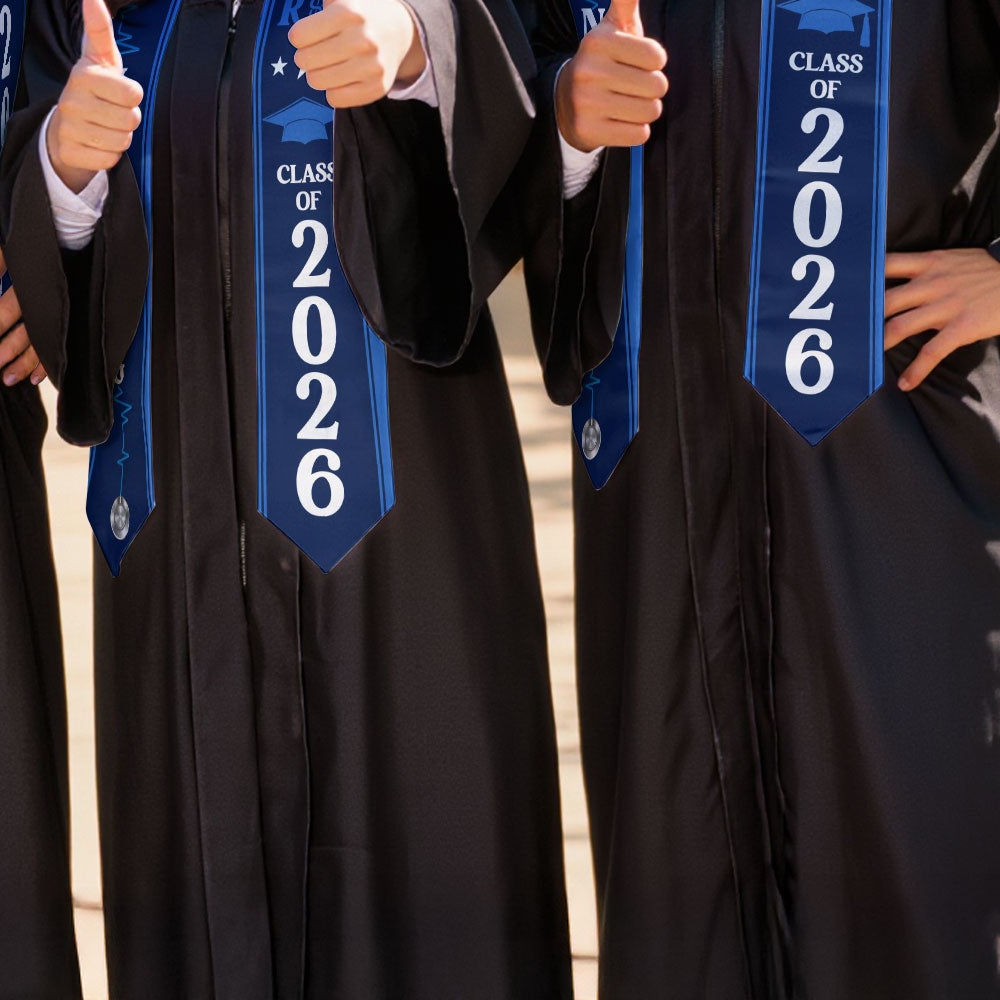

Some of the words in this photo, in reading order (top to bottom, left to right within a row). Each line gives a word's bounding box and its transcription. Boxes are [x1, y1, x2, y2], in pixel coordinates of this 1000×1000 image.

[788, 51, 863, 74] CLASS
[809, 79, 842, 99] OF
[276, 162, 334, 184] CLASS
[295, 190, 322, 211] OF
[784, 107, 846, 395] 2026
[291, 219, 345, 517] 2026
